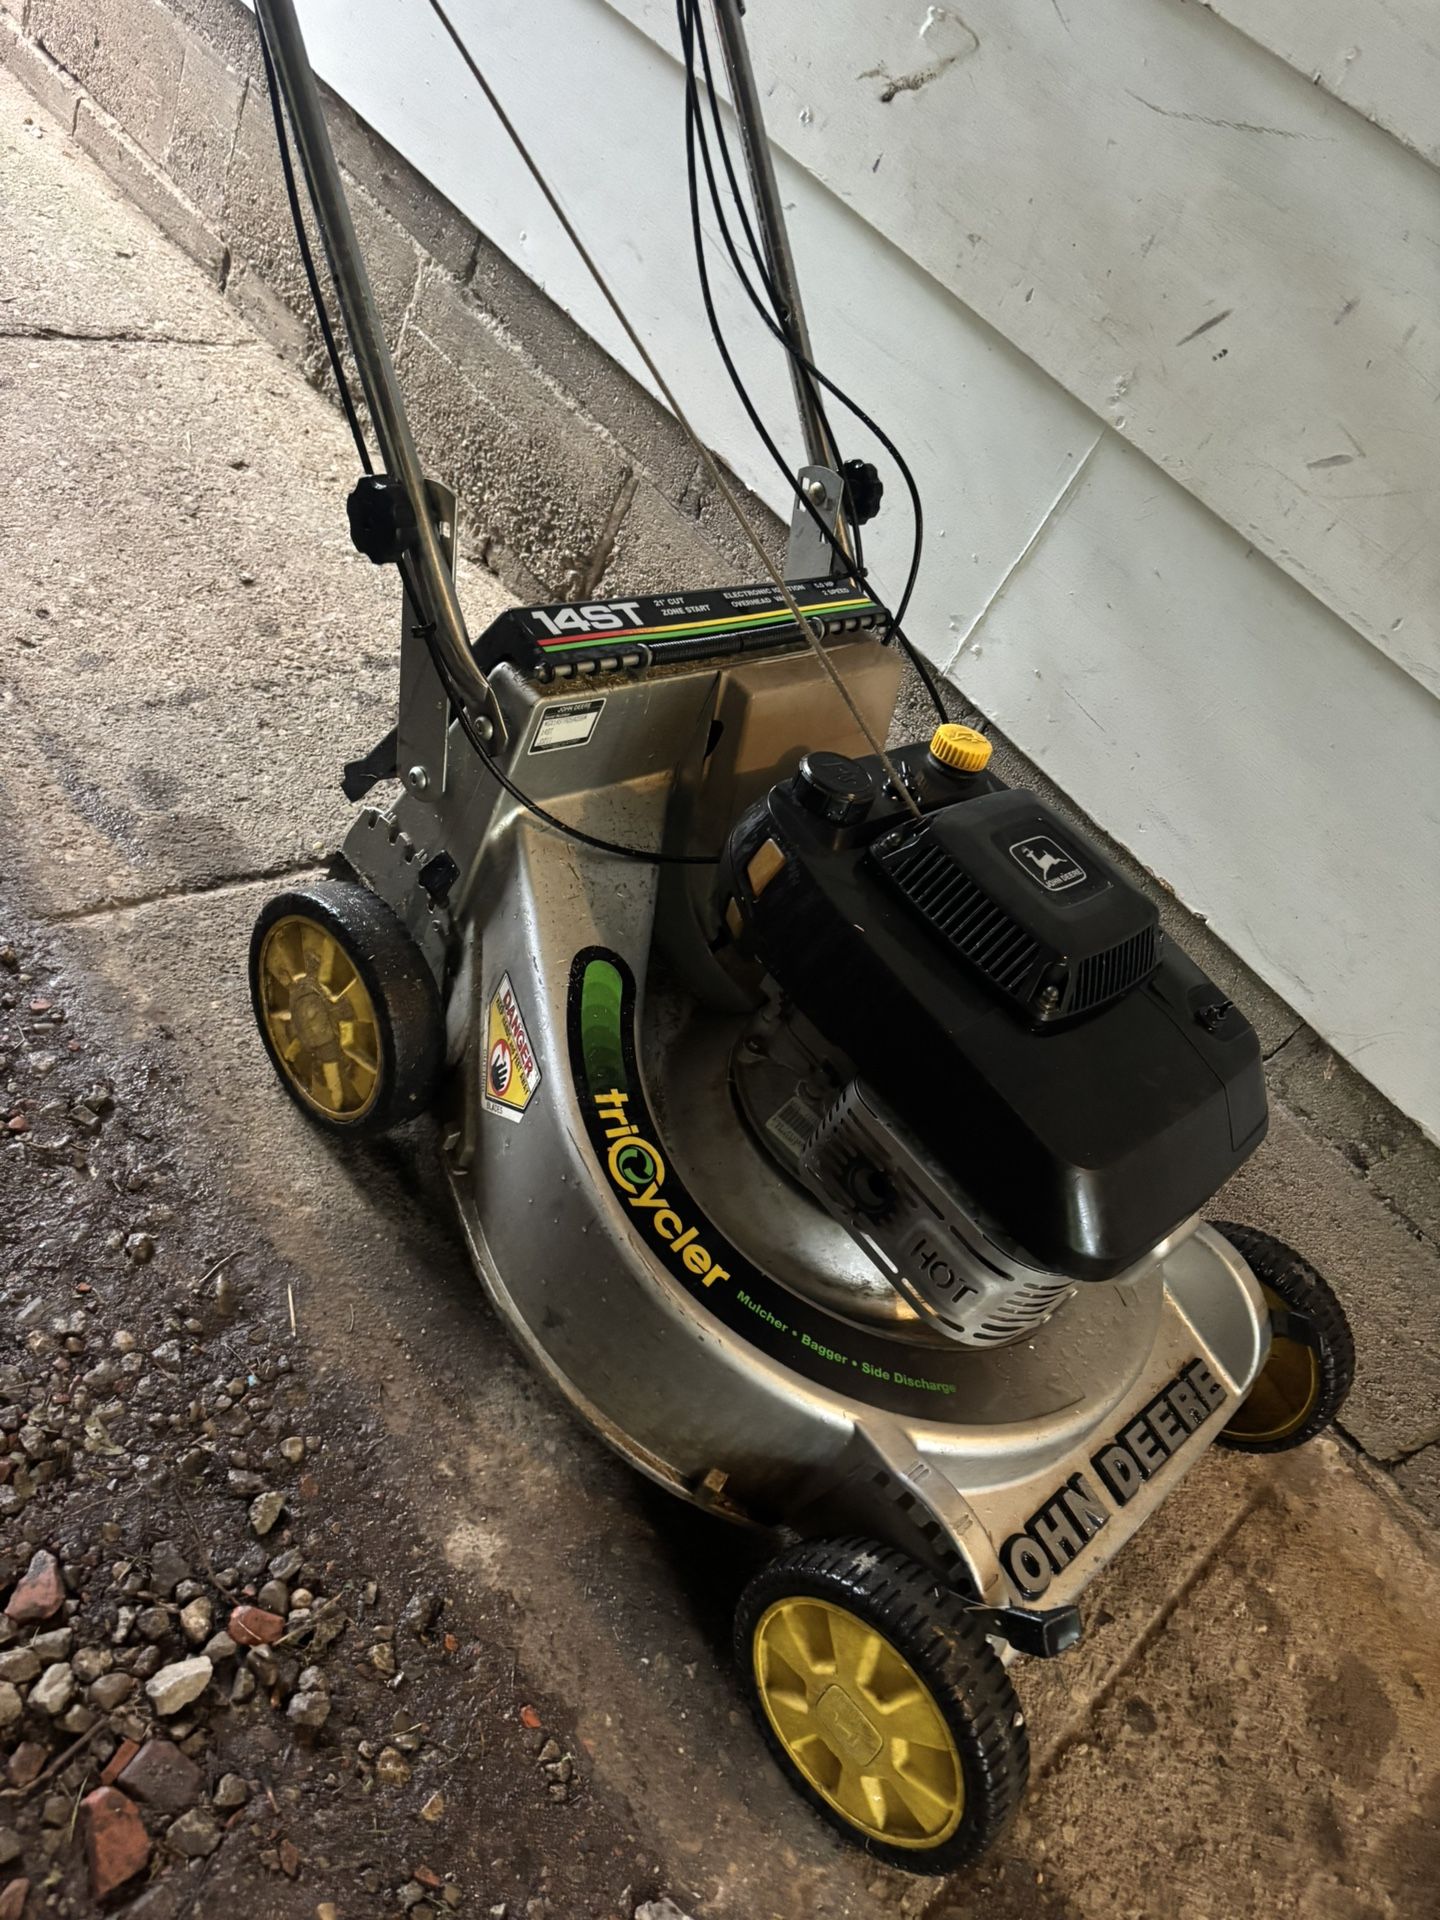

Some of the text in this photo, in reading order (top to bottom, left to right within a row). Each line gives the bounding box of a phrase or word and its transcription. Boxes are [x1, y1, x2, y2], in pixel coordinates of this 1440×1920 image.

[667, 597, 685, 605] CUT
[723, 584, 806, 599] ELECTRONIC IGTION
[731, 597, 772, 608] OVERHEAD
[827, 587, 850, 595] SPEED
[531, 602, 644, 635] 14ST
[661, 604, 711, 616] ZONE START
[503, 989, 534, 1079] DANGER
[911, 1238, 979, 1304] HOT
[736, 1290, 957, 1394] Mulcher Bagger Side Discharge
[1090, 1357, 1228, 1508] DEERE
